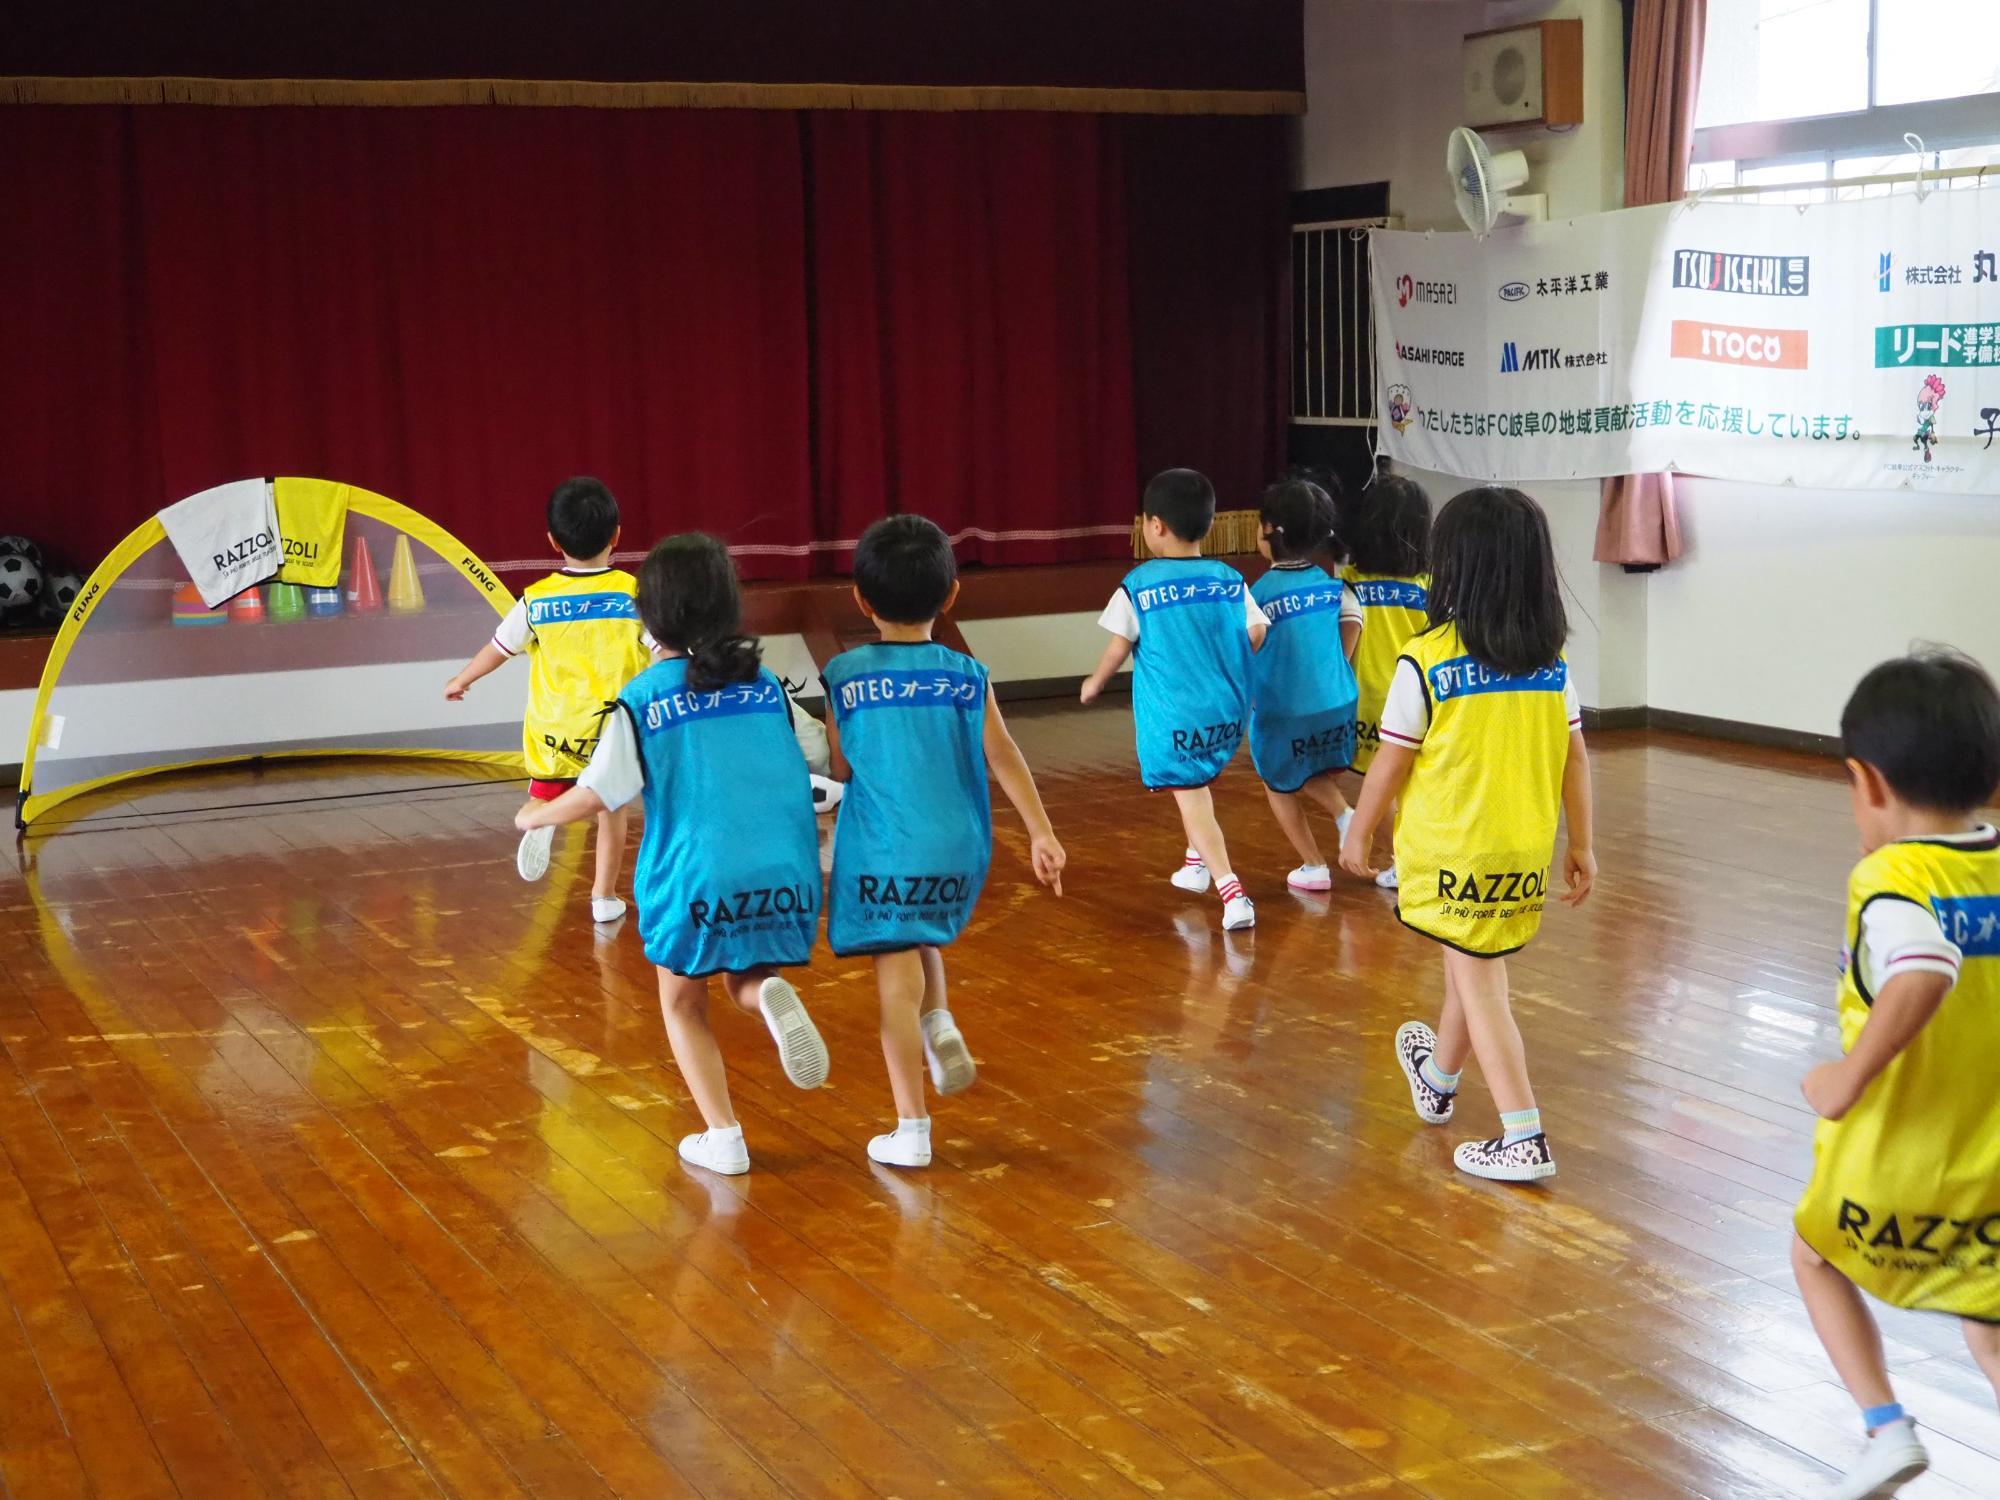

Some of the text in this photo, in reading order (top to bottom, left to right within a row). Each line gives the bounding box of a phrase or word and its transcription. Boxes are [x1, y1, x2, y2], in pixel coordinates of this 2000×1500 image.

[1536, 271, 1608, 297] 太平洋工業
[1905, 265, 1962, 285] 株式会社
[1894, 327, 1962, 364] リード
[1432, 349, 1464, 367] FORGE
[1522, 348, 1608, 371] MTK 株式会社
[462, 557, 496, 592] FUNG
[1182, 582, 1241, 598] オーテック
[73, 583, 100, 622] FUNG
[898, 678, 976, 700] オーテック
[689, 883, 814, 929] RAZZOLI
